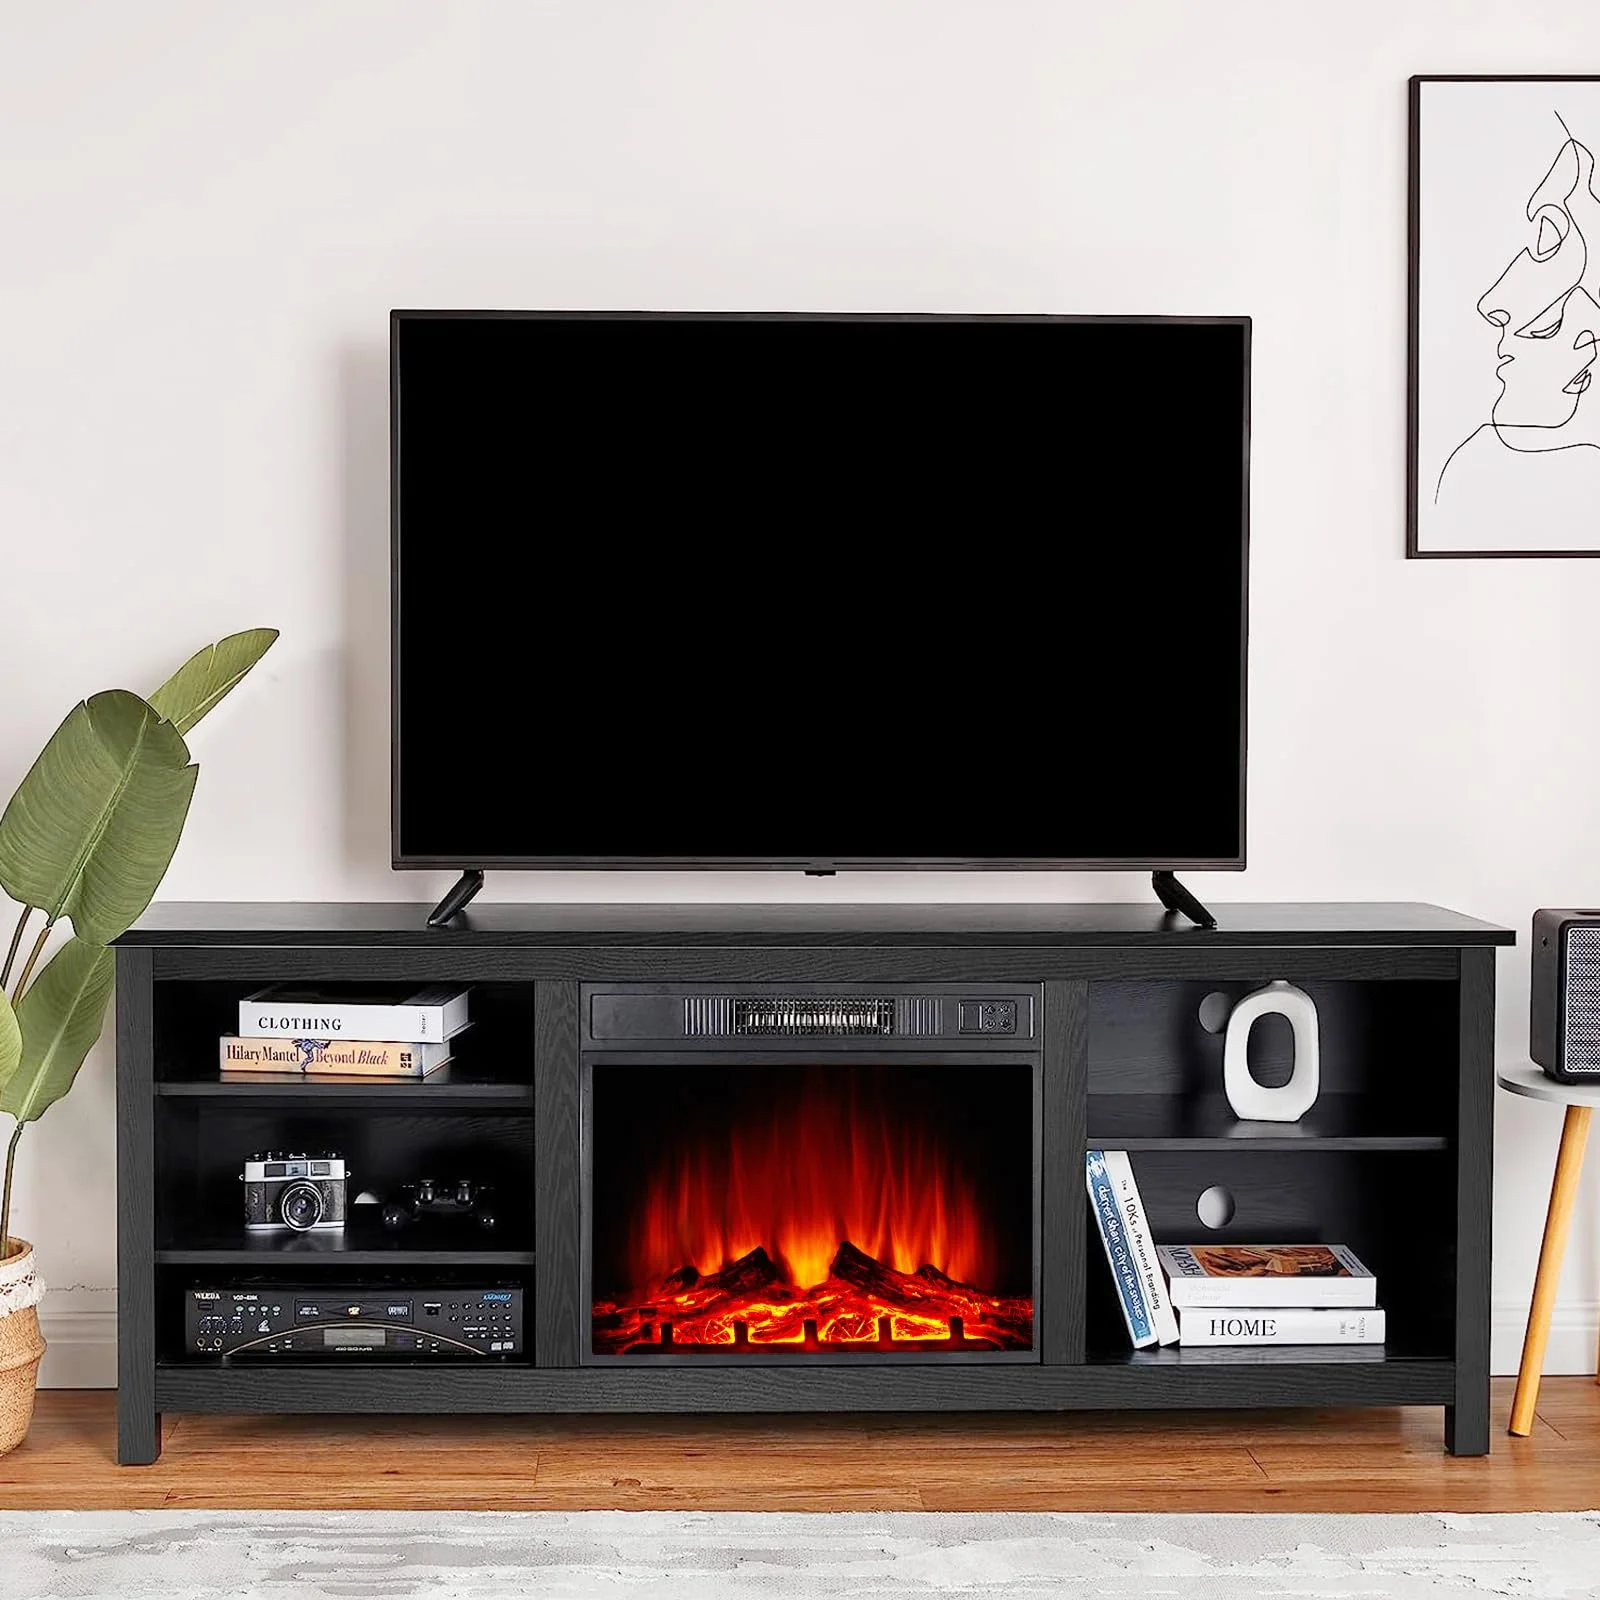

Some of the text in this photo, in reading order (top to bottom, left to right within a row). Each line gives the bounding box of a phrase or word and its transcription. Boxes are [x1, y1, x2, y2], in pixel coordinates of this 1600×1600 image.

[257, 1016, 342, 1031] CLOTHING
[226, 1045, 261, 1064] Hilary
[262, 1046, 300, 1062] Mantel
[357, 1050, 389, 1066] Black
[1123, 1196, 1139, 1227] 10Ks
[1135, 1233, 1151, 1270] Personal
[1147, 1273, 1160, 1309] Branding
[1208, 1318, 1278, 1338] HOME
